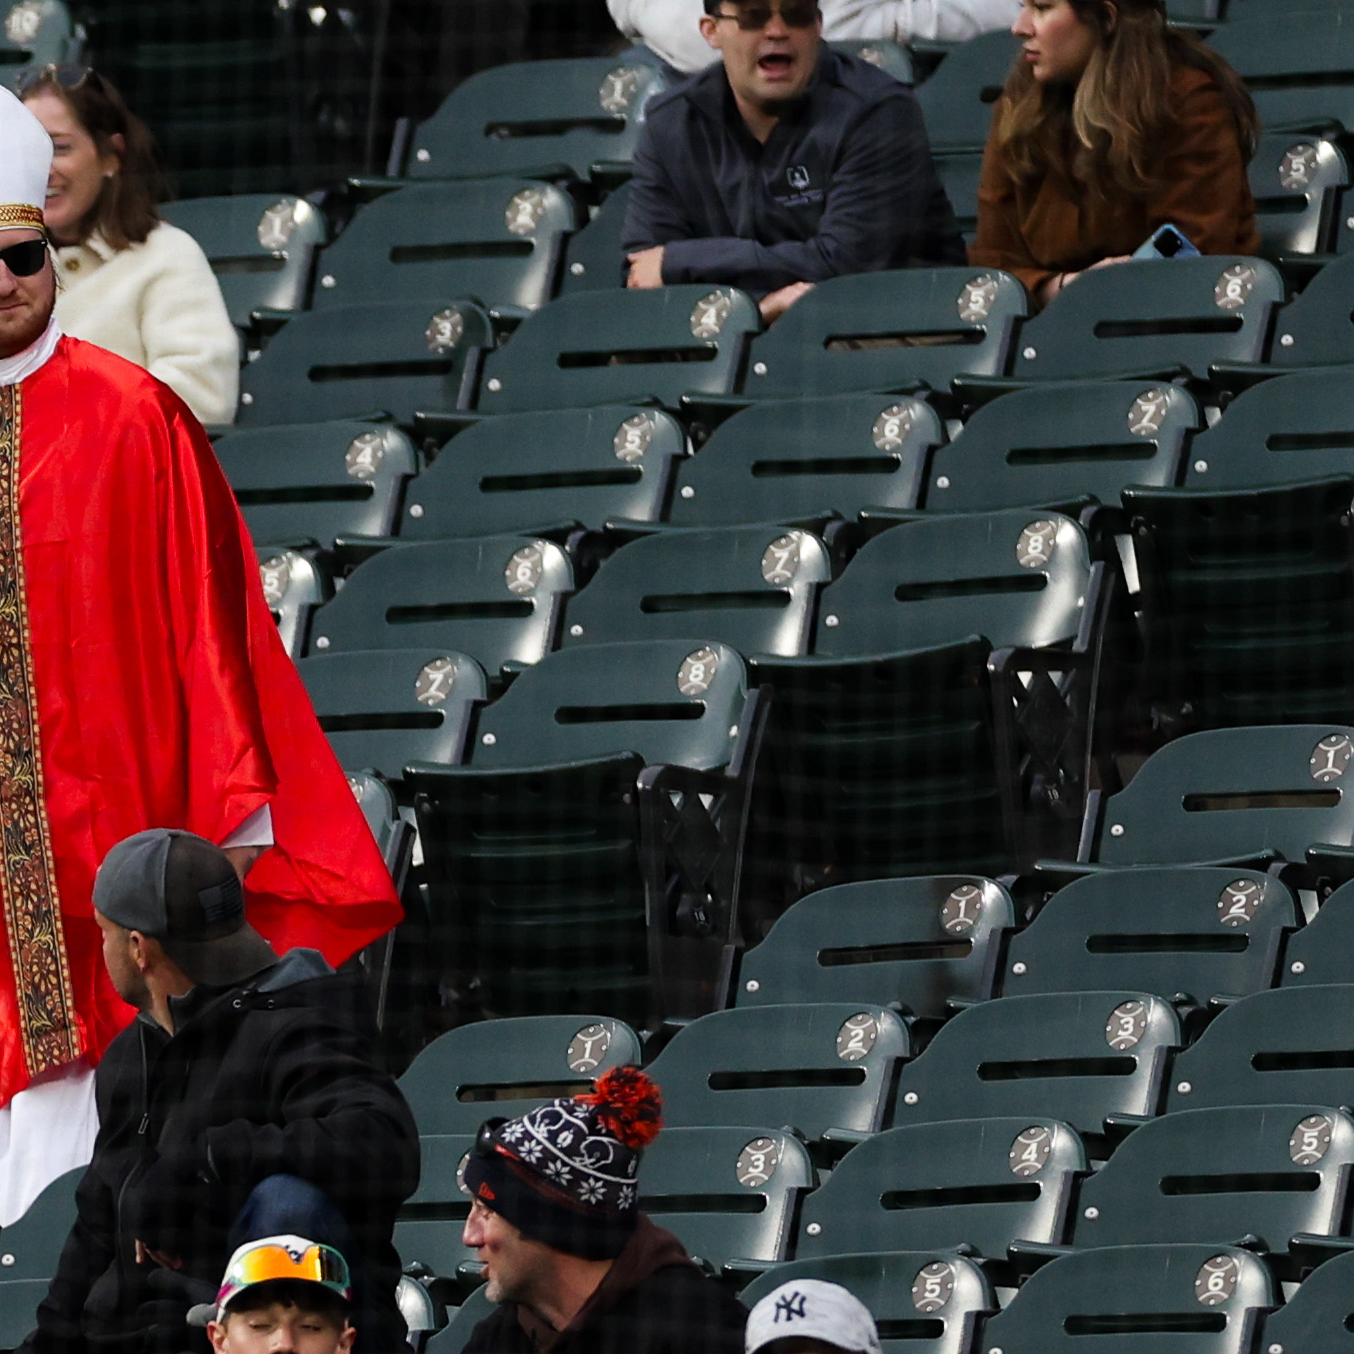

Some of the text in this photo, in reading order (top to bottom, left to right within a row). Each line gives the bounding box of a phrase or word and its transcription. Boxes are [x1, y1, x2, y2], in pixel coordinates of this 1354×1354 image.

[1291, 157, 1305, 178] 5
[1227, 278, 1241, 298] 6
[970, 290, 983, 310] 5
[702, 308, 717, 326] 4
[437, 322, 451, 341] 3
[1141, 406, 1156, 424] 7
[885, 418, 899, 439] 6
[626, 430, 640, 450] 5
[357, 446, 371, 466] 4
[1028, 535, 1043, 556] 8
[775, 551, 788, 572] 7
[265, 572, 278, 591] 5
[517, 562, 531, 582] 6
[690, 664, 704, 684] 8
[429, 675, 443, 693] 7
[1230, 894, 1246, 913] 2
[1118, 1018, 1133, 1036] 3
[849, 1029, 863, 1047] 2
[1302, 1132, 1317, 1150] 5
[1022, 1143, 1037, 1161] 4
[748, 1154, 764, 1172] 3
[925, 1278, 940, 1298] 5
[1209, 1272, 1224, 1291] 6
[774, 1291, 806, 1323] NY
